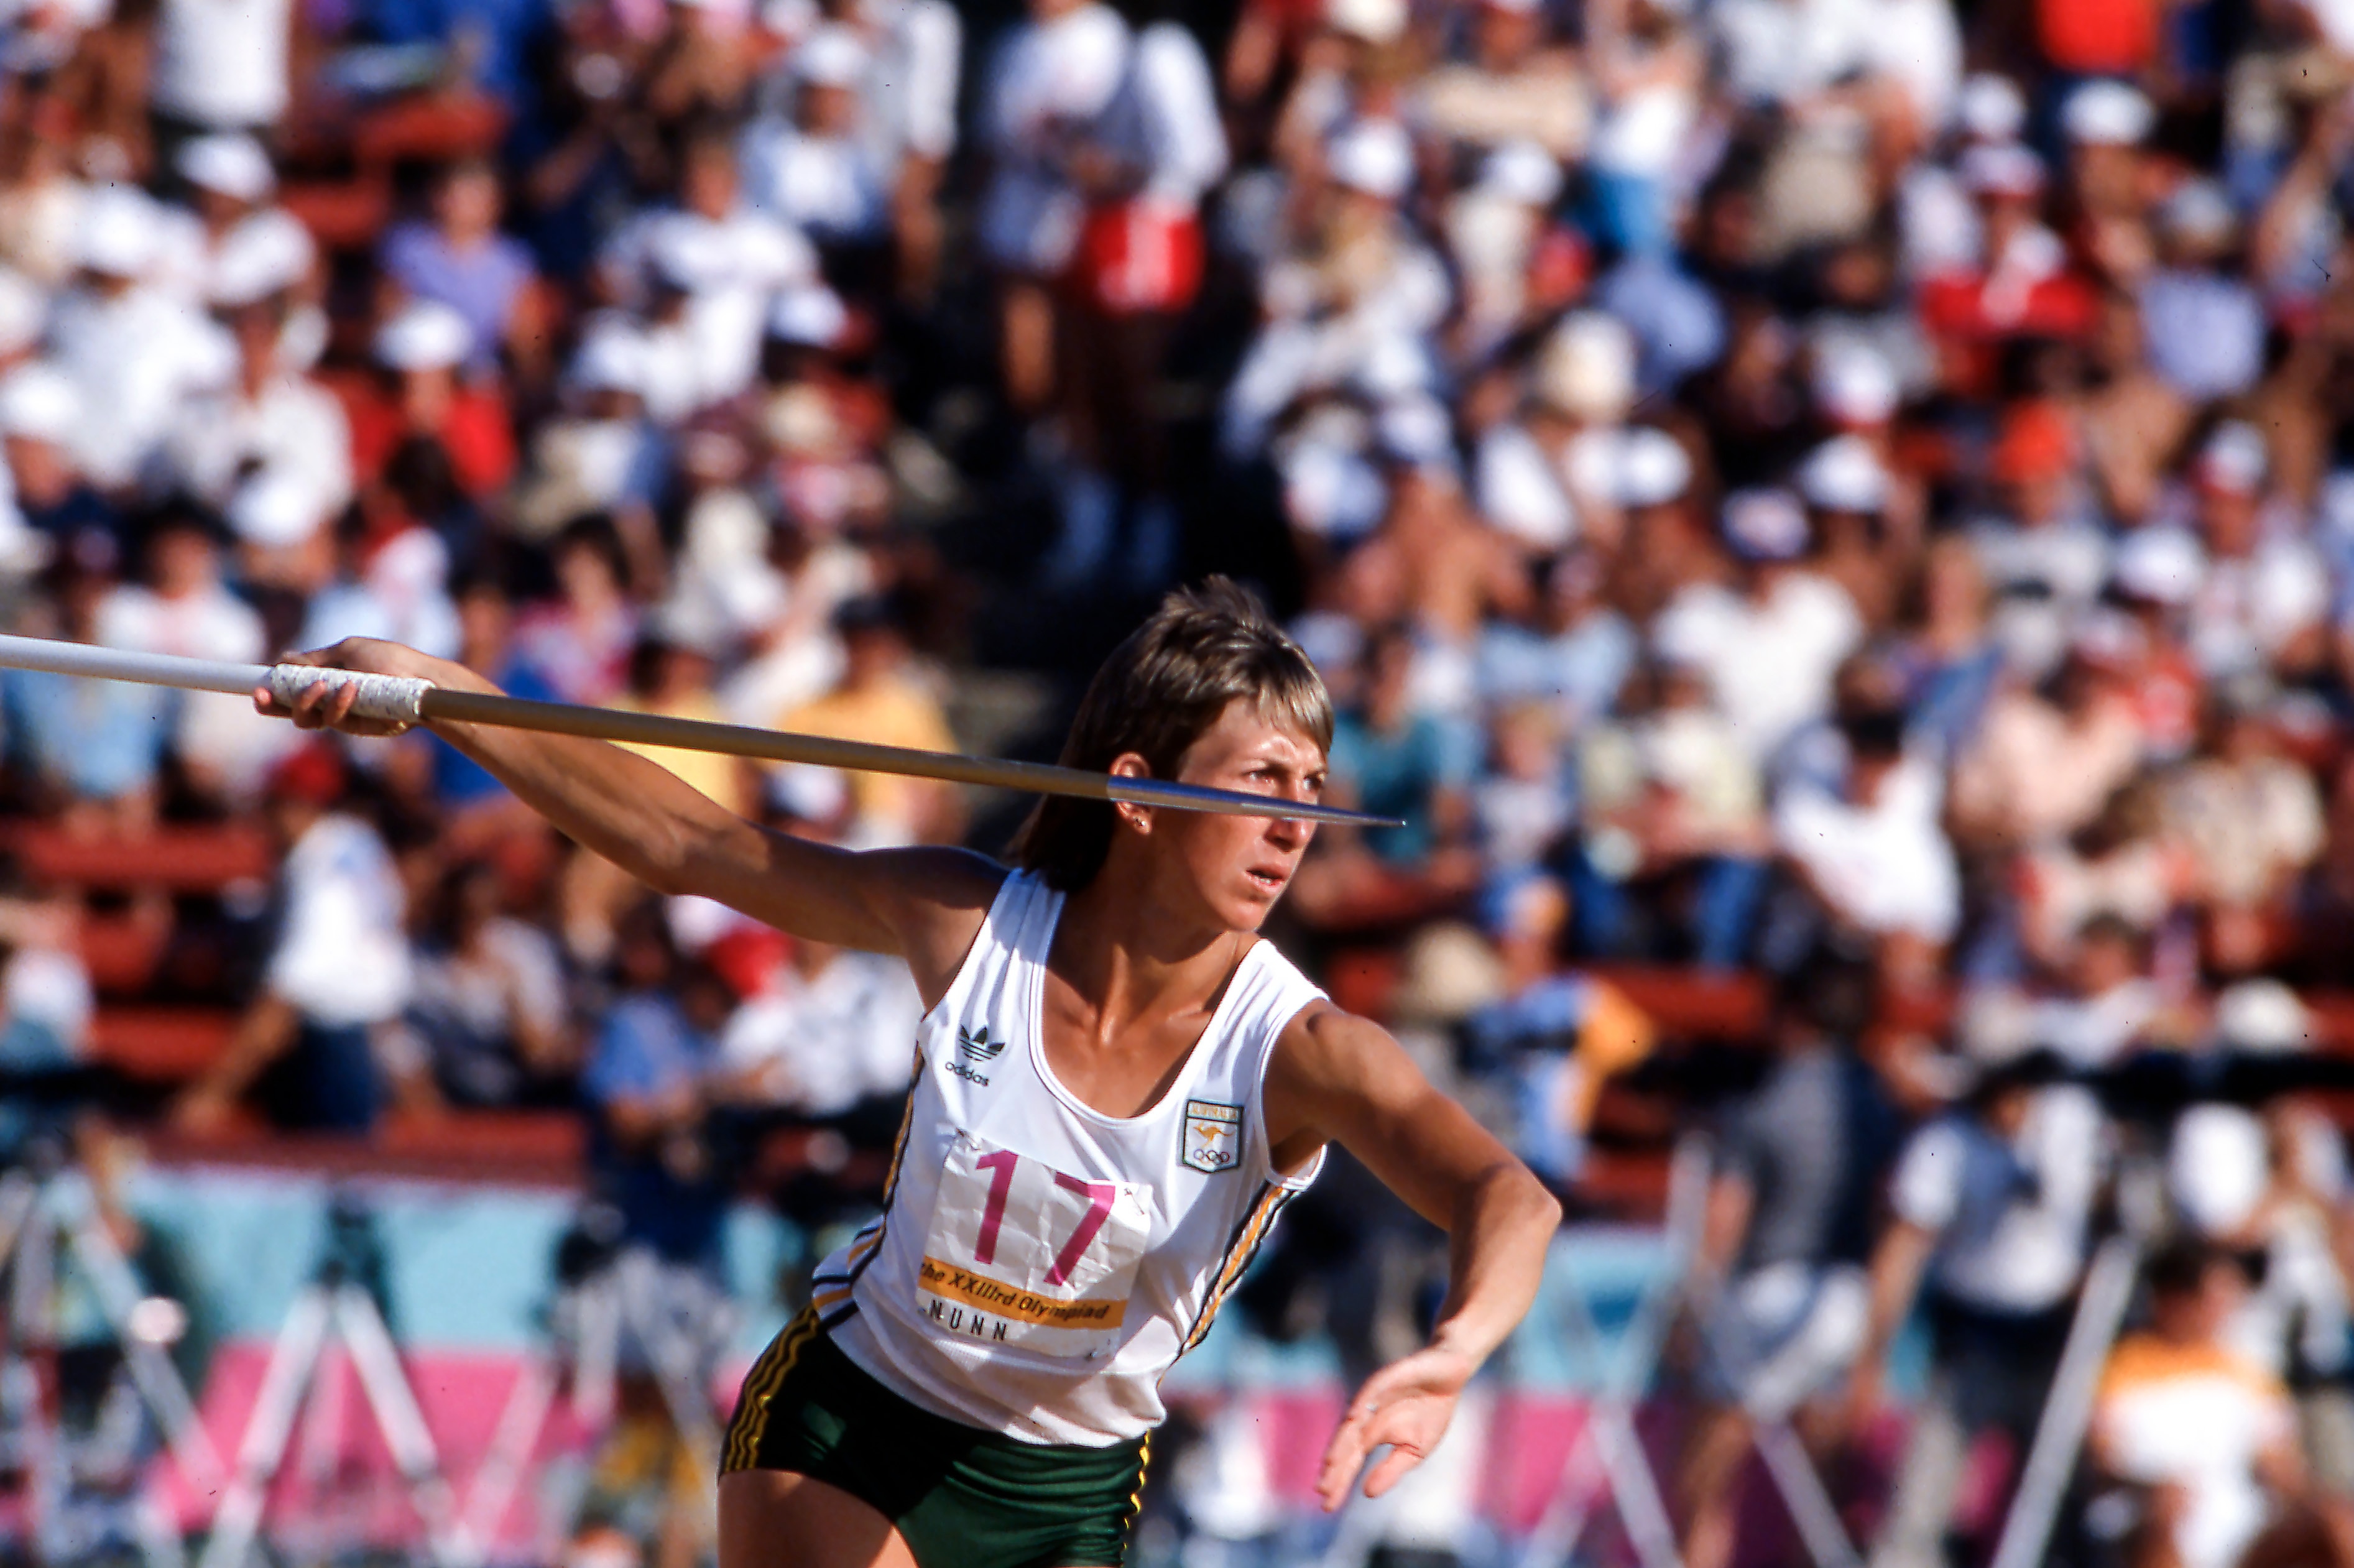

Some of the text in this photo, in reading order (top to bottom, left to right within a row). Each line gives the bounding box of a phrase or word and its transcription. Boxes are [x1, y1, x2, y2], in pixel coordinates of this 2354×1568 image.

[945, 1062, 989, 1087] adidas
[975, 1149, 1116, 1286] 17
[920, 1263, 945, 1281] he
[1019, 1297, 1110, 1322] Olympiad
[930, 1299, 1007, 1340] NUNN
